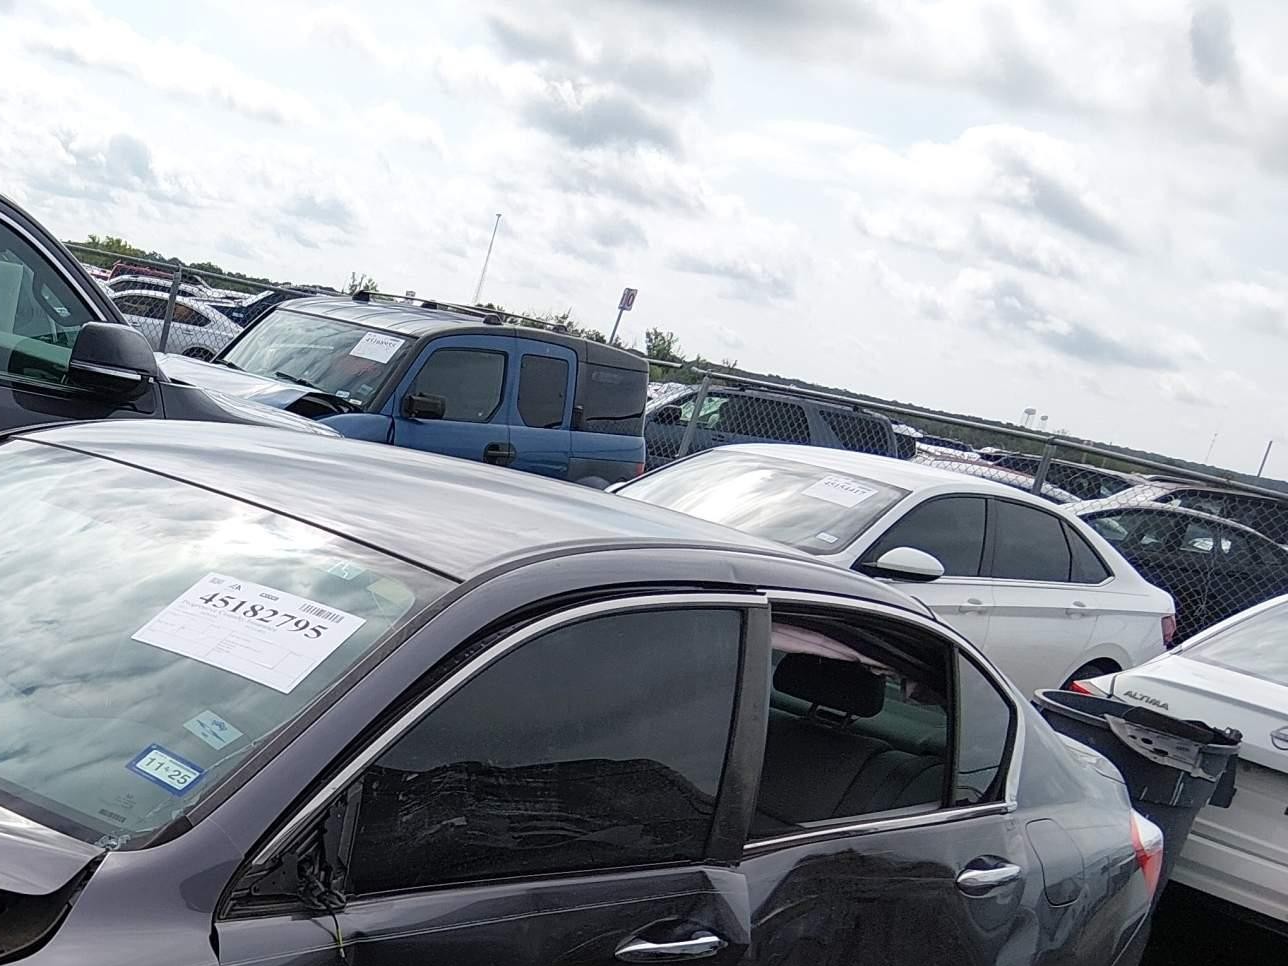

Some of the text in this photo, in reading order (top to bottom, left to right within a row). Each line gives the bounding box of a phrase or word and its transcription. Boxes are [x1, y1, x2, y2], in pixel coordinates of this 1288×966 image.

[620, 293, 635, 306] 10
[199, 592, 328, 640] 45182795
[1123, 690, 1169, 711] ALTIMA
[144, 756, 192, 785] 11 25
